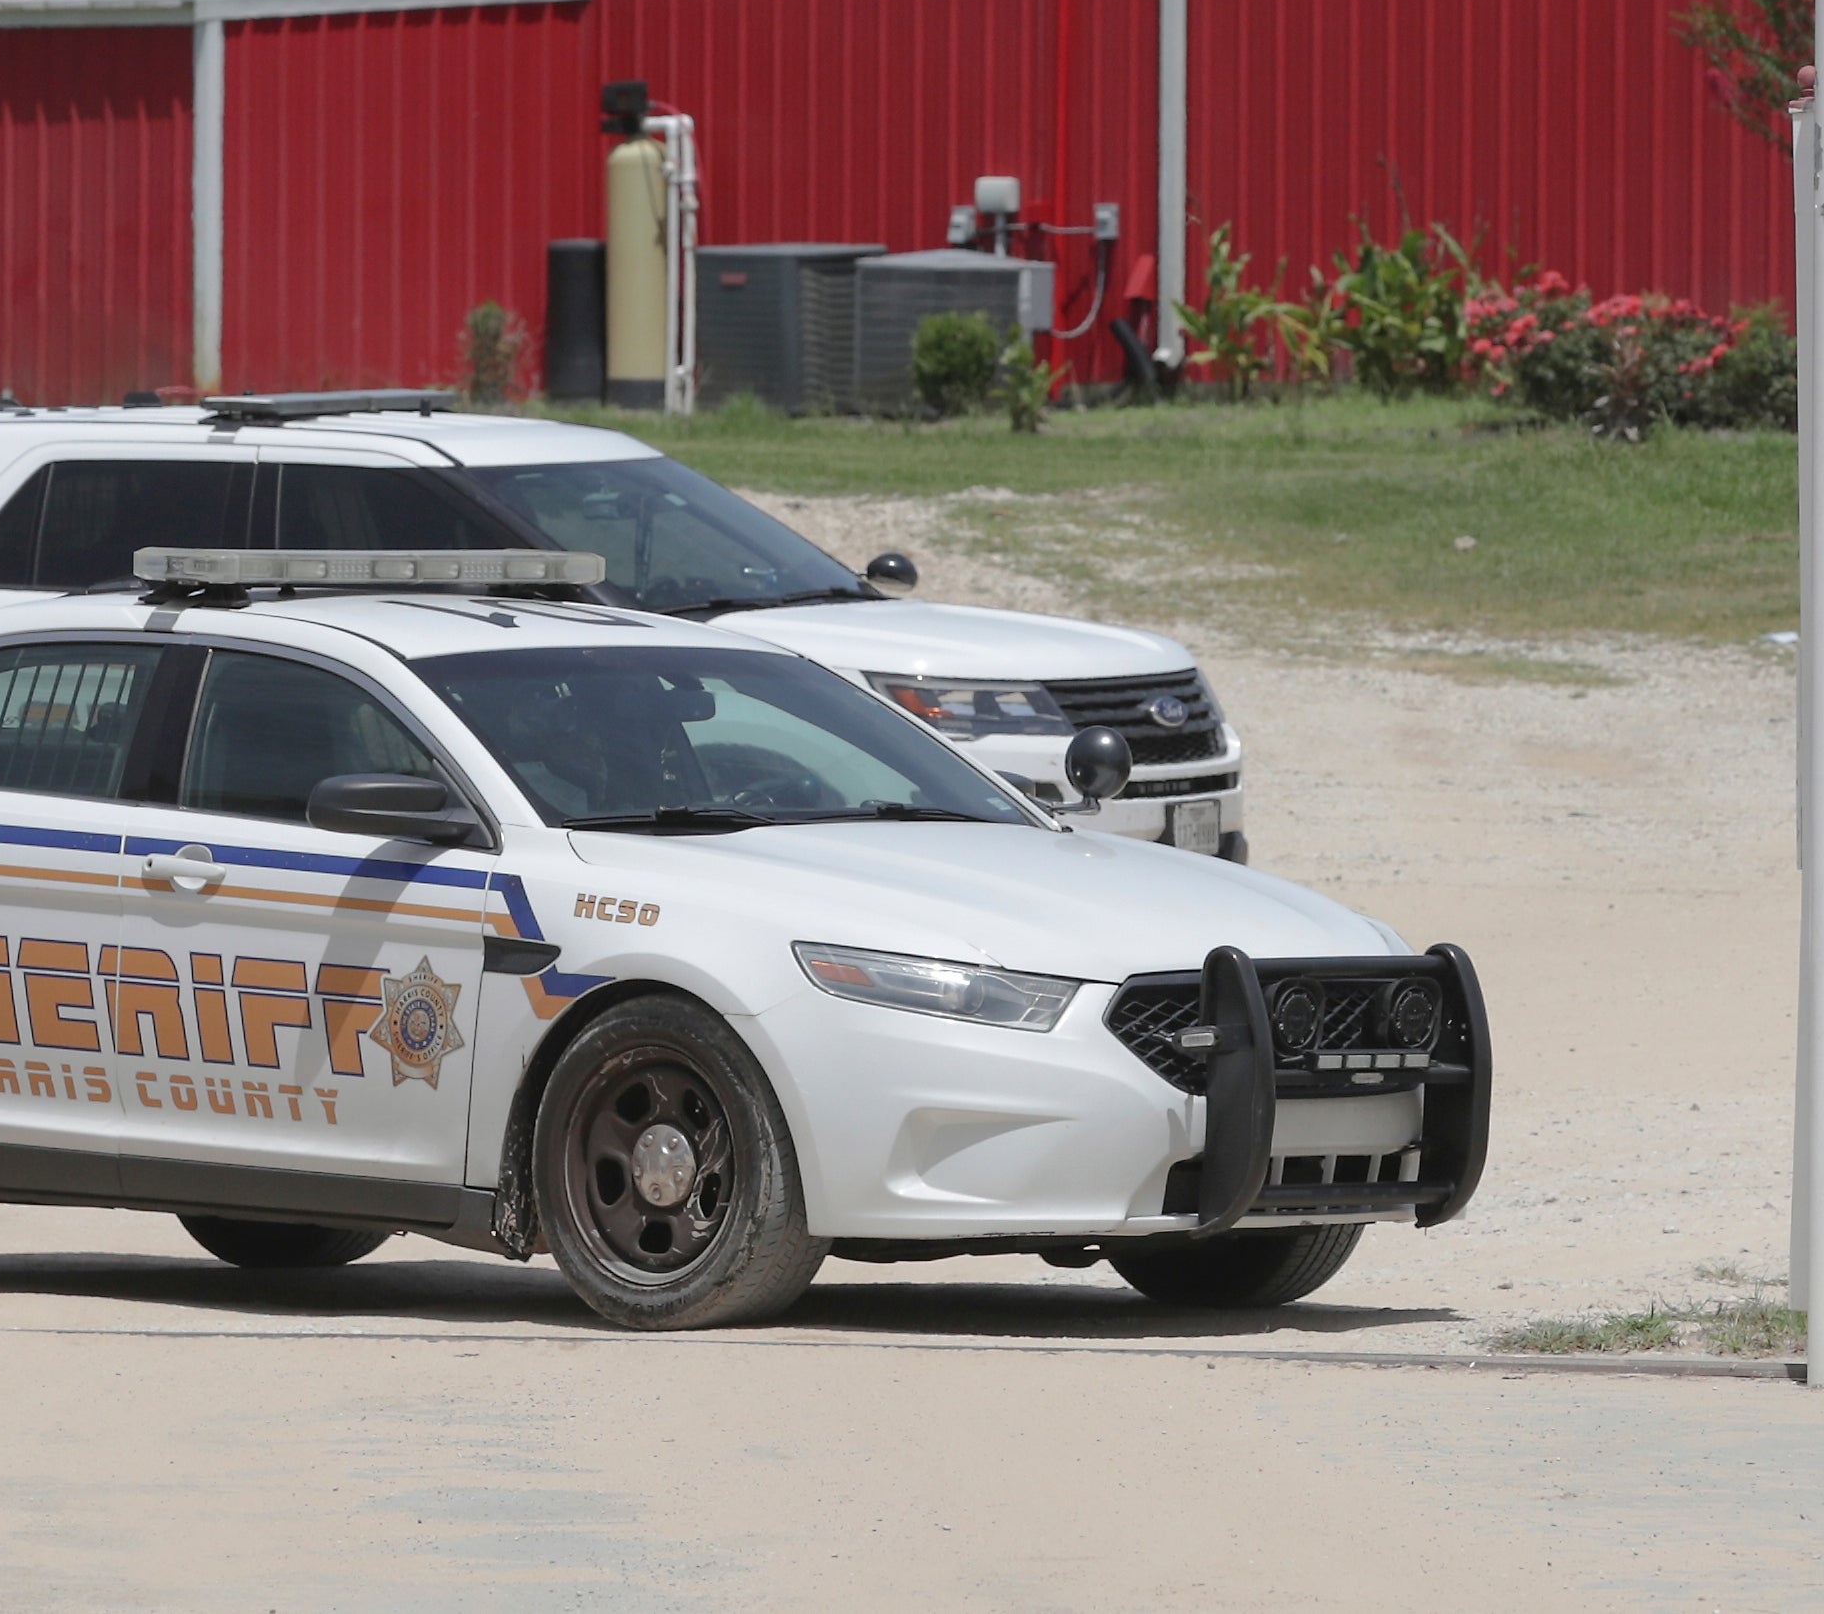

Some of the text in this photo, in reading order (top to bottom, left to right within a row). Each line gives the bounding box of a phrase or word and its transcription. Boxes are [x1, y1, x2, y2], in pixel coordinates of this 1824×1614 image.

[573, 893, 661, 926] HCSO
[395, 988, 444, 1017] HARRIS COUNTY
[135, 1071, 339, 1125] COUNTY
